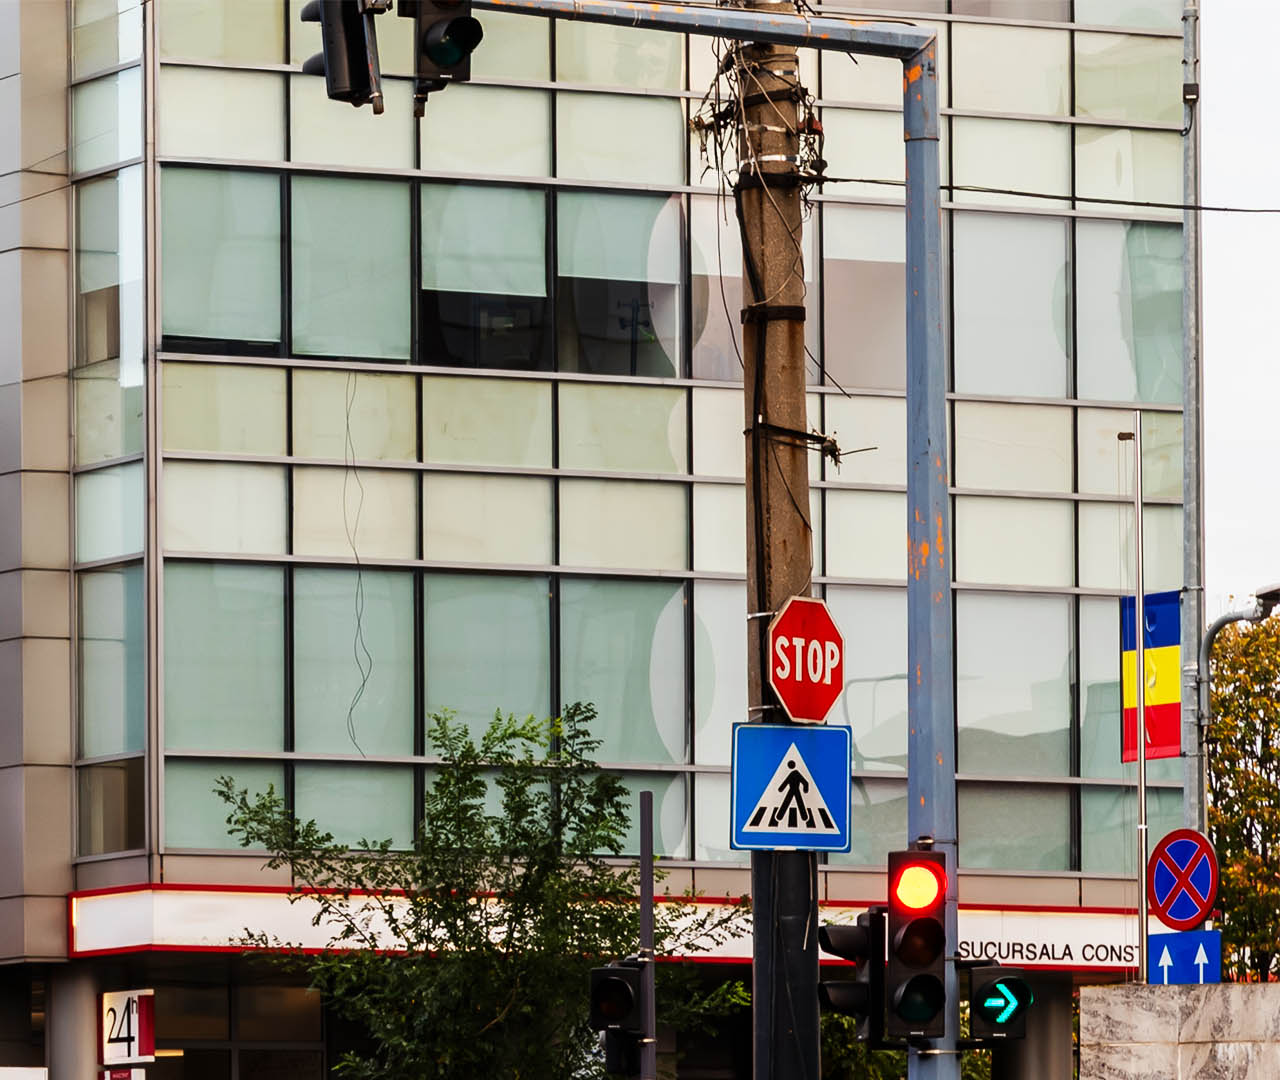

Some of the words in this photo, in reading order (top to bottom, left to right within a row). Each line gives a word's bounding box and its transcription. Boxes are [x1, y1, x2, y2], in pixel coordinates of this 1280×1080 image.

[775, 635, 840, 685] STOP
[958, 941, 1074, 961] SUCURSALA
[1081, 943, 1140, 963] CONS
